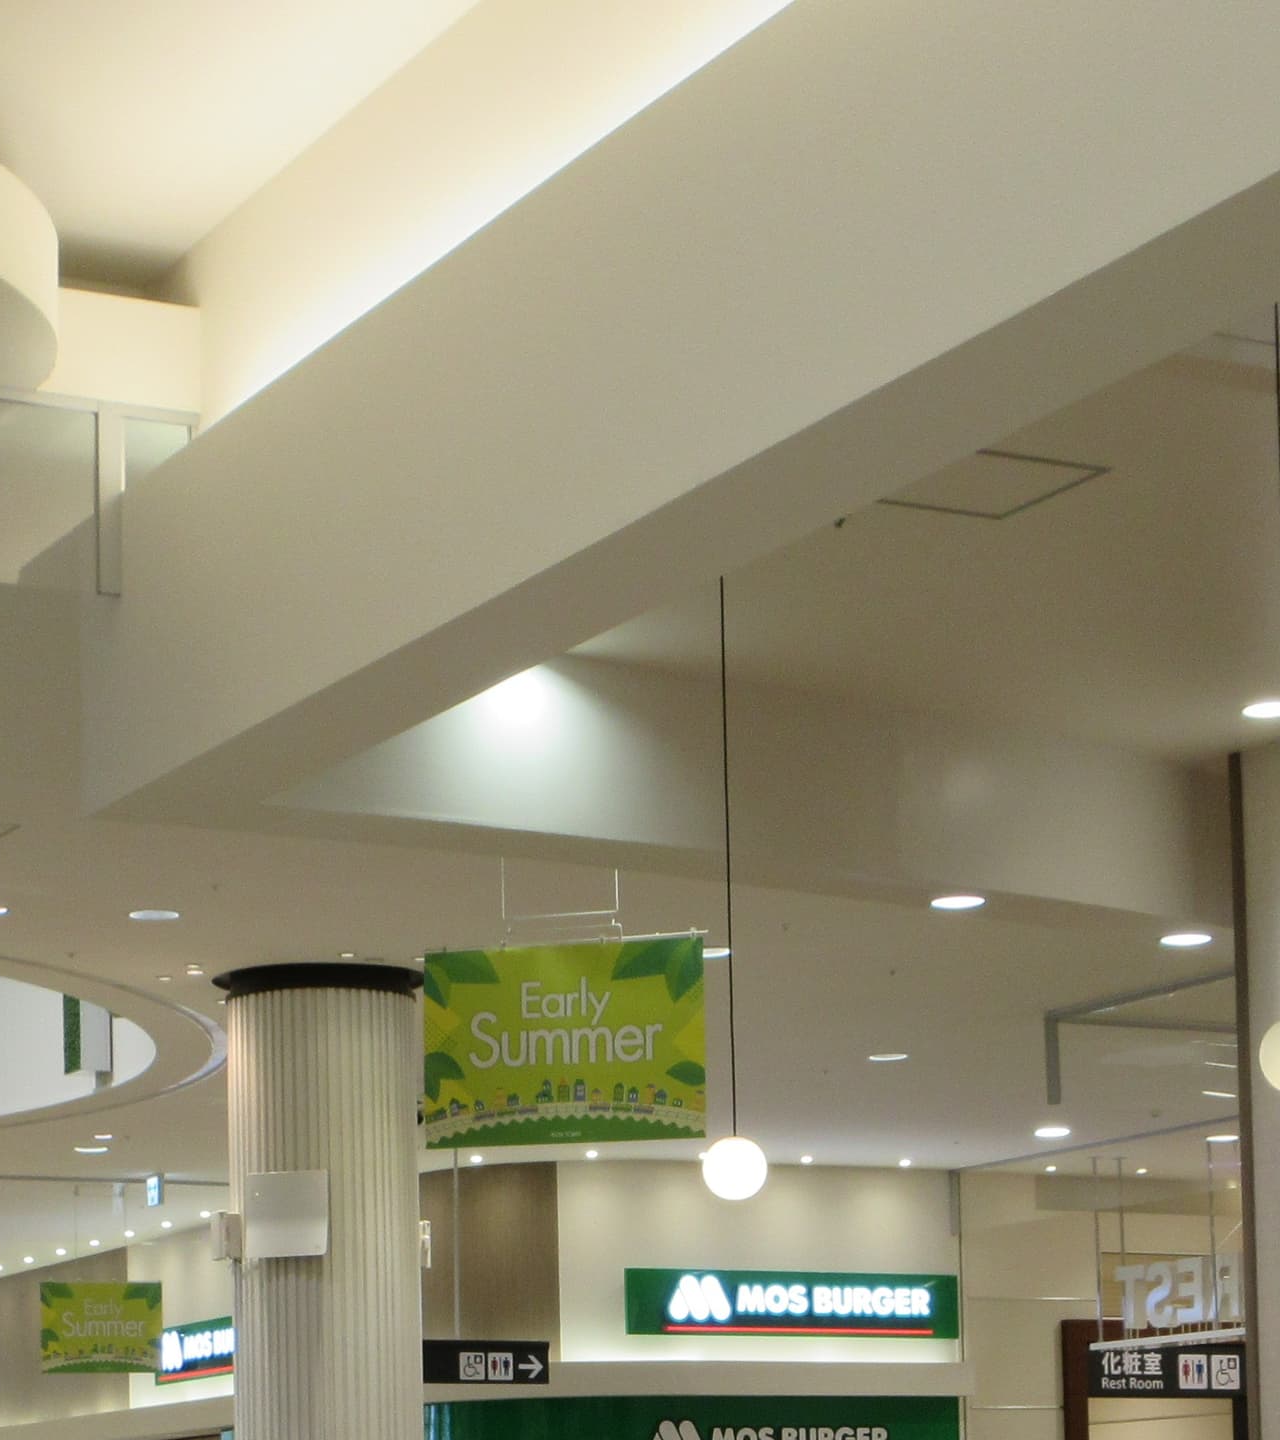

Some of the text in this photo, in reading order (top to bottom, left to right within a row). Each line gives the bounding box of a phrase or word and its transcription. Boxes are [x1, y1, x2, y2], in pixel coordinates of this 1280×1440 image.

[520, 975, 612, 1026] Early
[468, 1011, 664, 1070] Summer
[83, 1299, 123, 1319] Early
[736, 1284, 931, 1317] MOS BURGER
[61, 1312, 145, 1338] Summer
[1101, 1351, 1163, 1376] 化粧室
[1101, 1376, 1164, 1390] Rest Room
